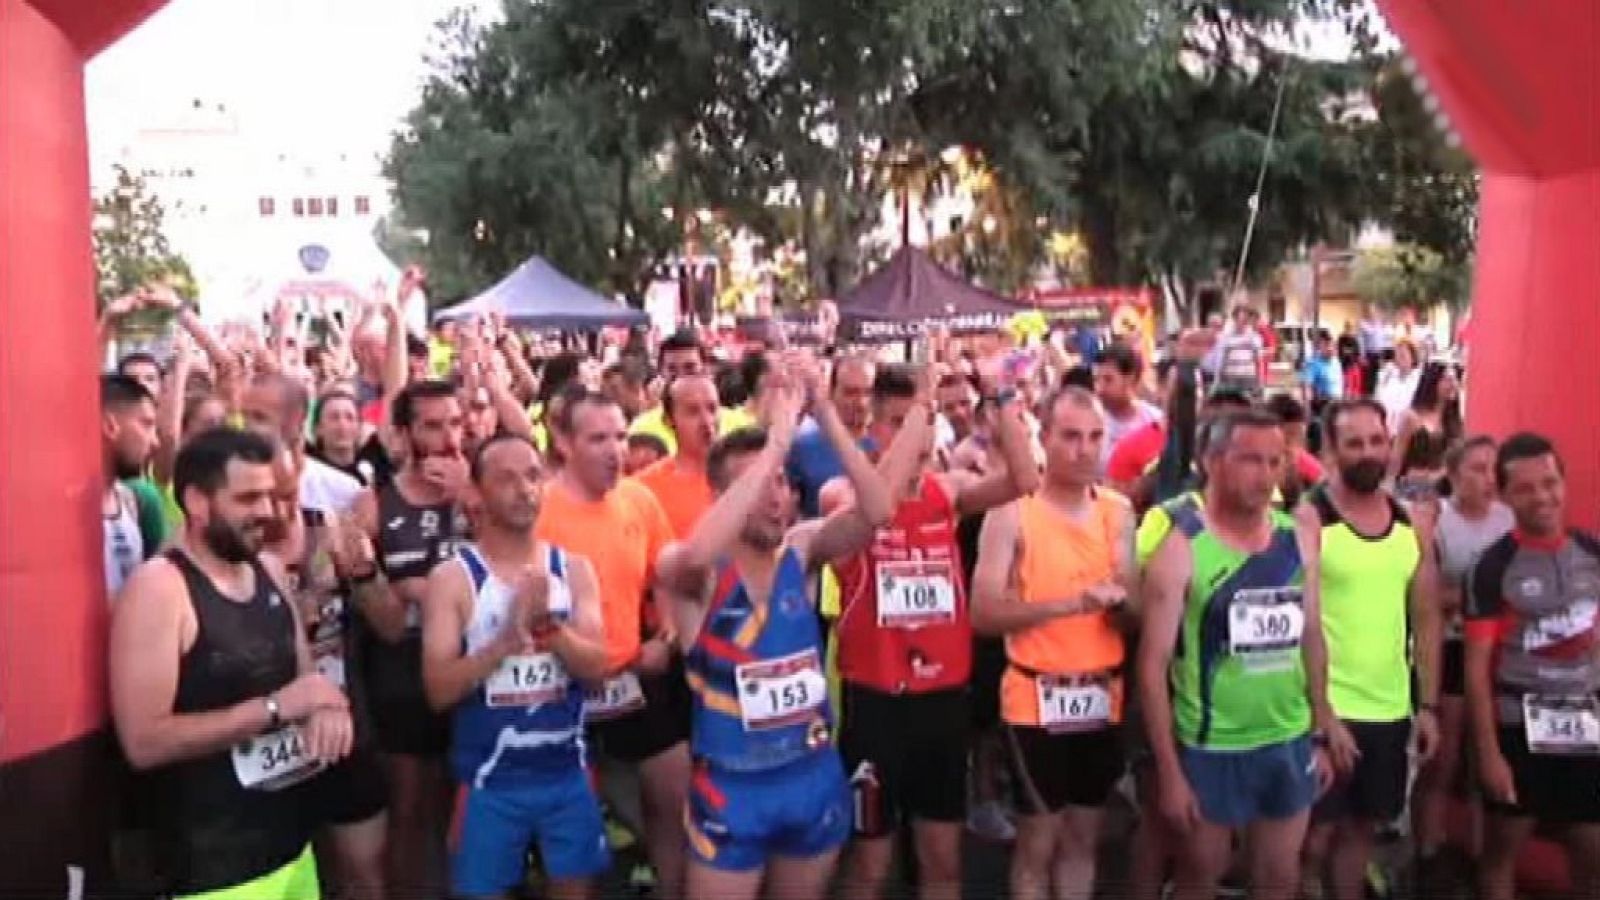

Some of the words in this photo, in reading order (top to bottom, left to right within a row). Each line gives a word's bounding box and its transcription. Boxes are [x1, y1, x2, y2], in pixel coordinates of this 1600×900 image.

[512, 661, 551, 687] 162
[768, 680, 809, 712] 153
[1058, 694, 1092, 717] 167
[260, 735, 302, 770] 344
